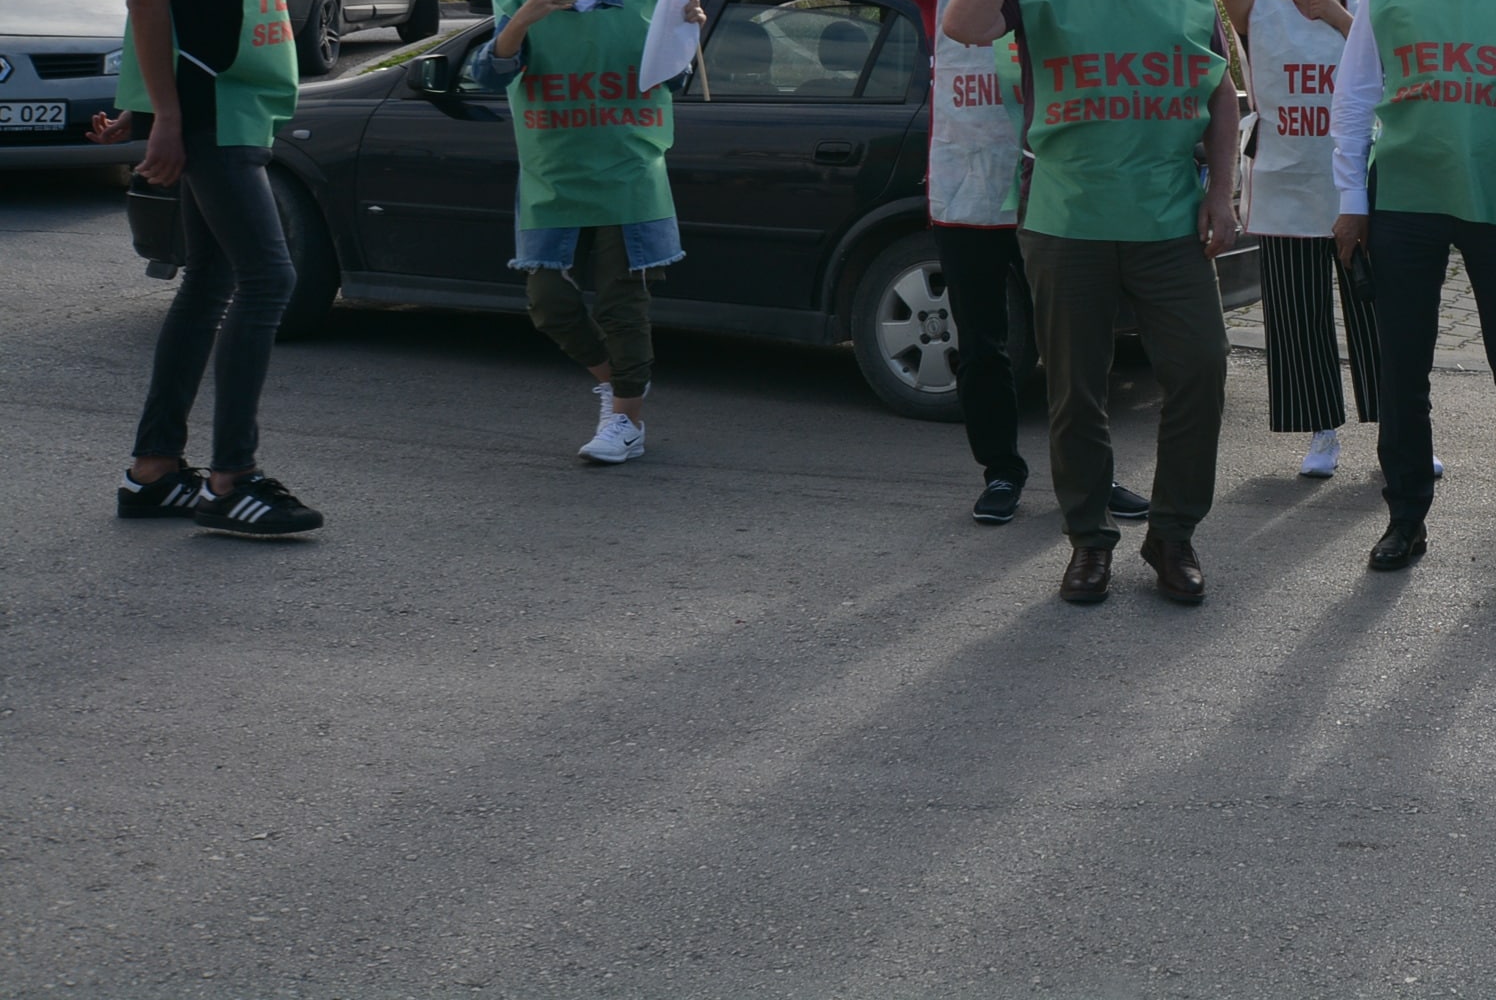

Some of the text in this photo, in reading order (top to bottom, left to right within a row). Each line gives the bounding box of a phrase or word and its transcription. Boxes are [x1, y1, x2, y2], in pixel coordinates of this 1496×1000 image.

[523, 65, 662, 103] TEKSİ
[1043, 45, 1211, 93] TEKSİF
[1283, 63, 1337, 95] TEK
[20, 105, 63, 123] 022
[523, 104, 664, 130] SENDİKASI
[1045, 90, 1201, 125] SENDİKASI
